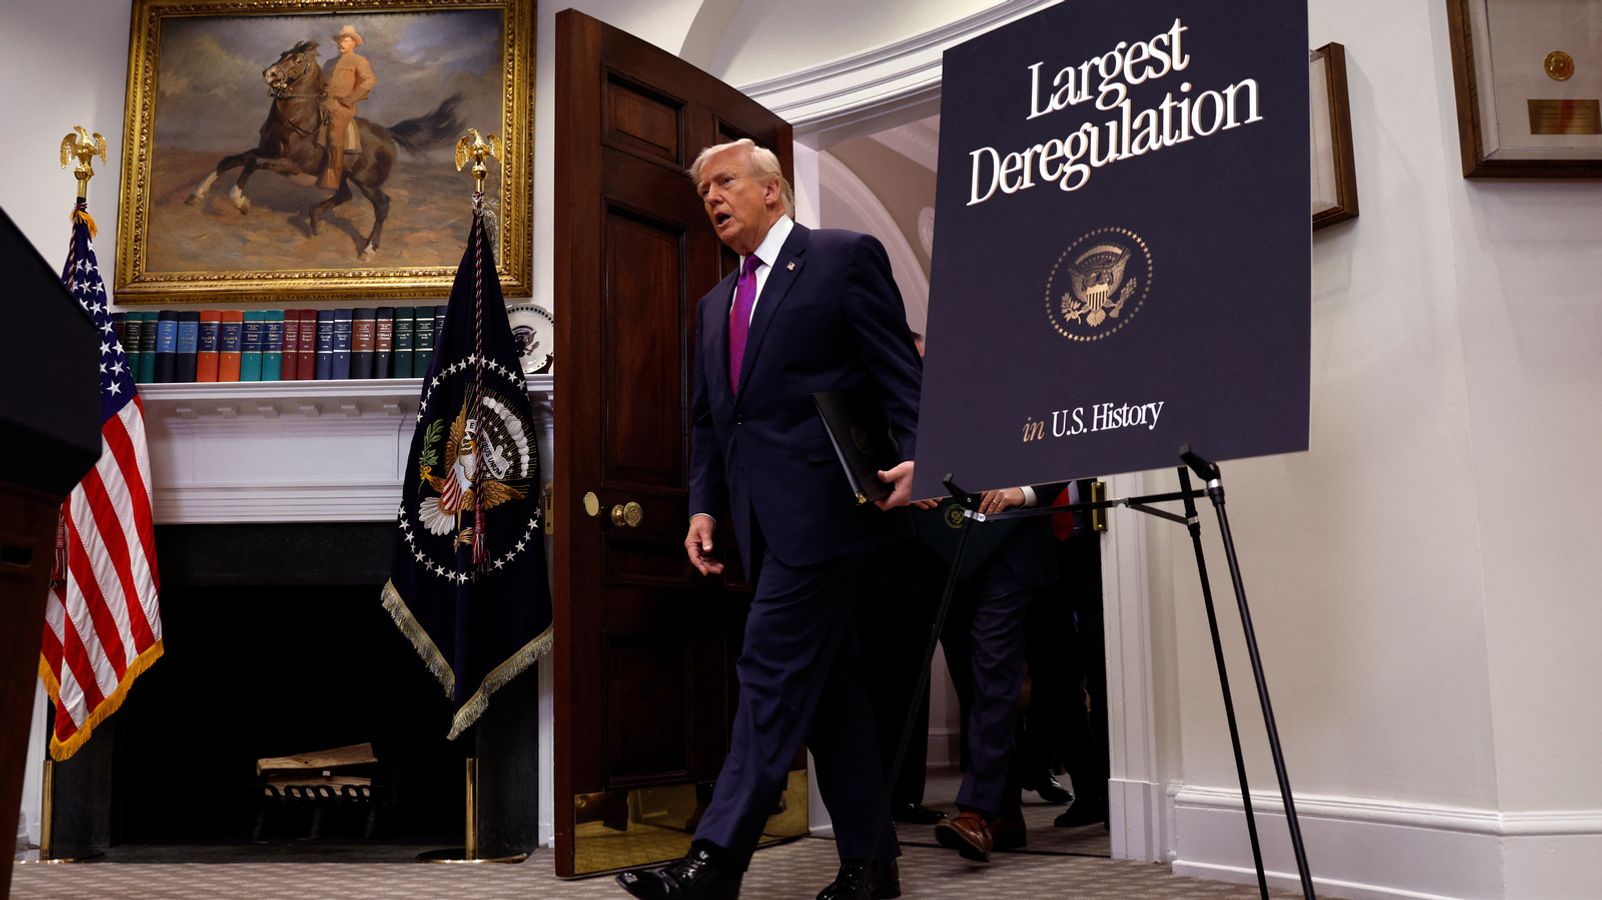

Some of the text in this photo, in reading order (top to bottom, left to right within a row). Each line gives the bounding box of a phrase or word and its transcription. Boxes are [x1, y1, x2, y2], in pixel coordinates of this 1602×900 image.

[1026, 17, 1190, 120] Largest
[966, 78, 1263, 206] Deregulation
[1023, 401, 1164, 442] in U.S. History
[488, 457, 502, 475] UNUM
